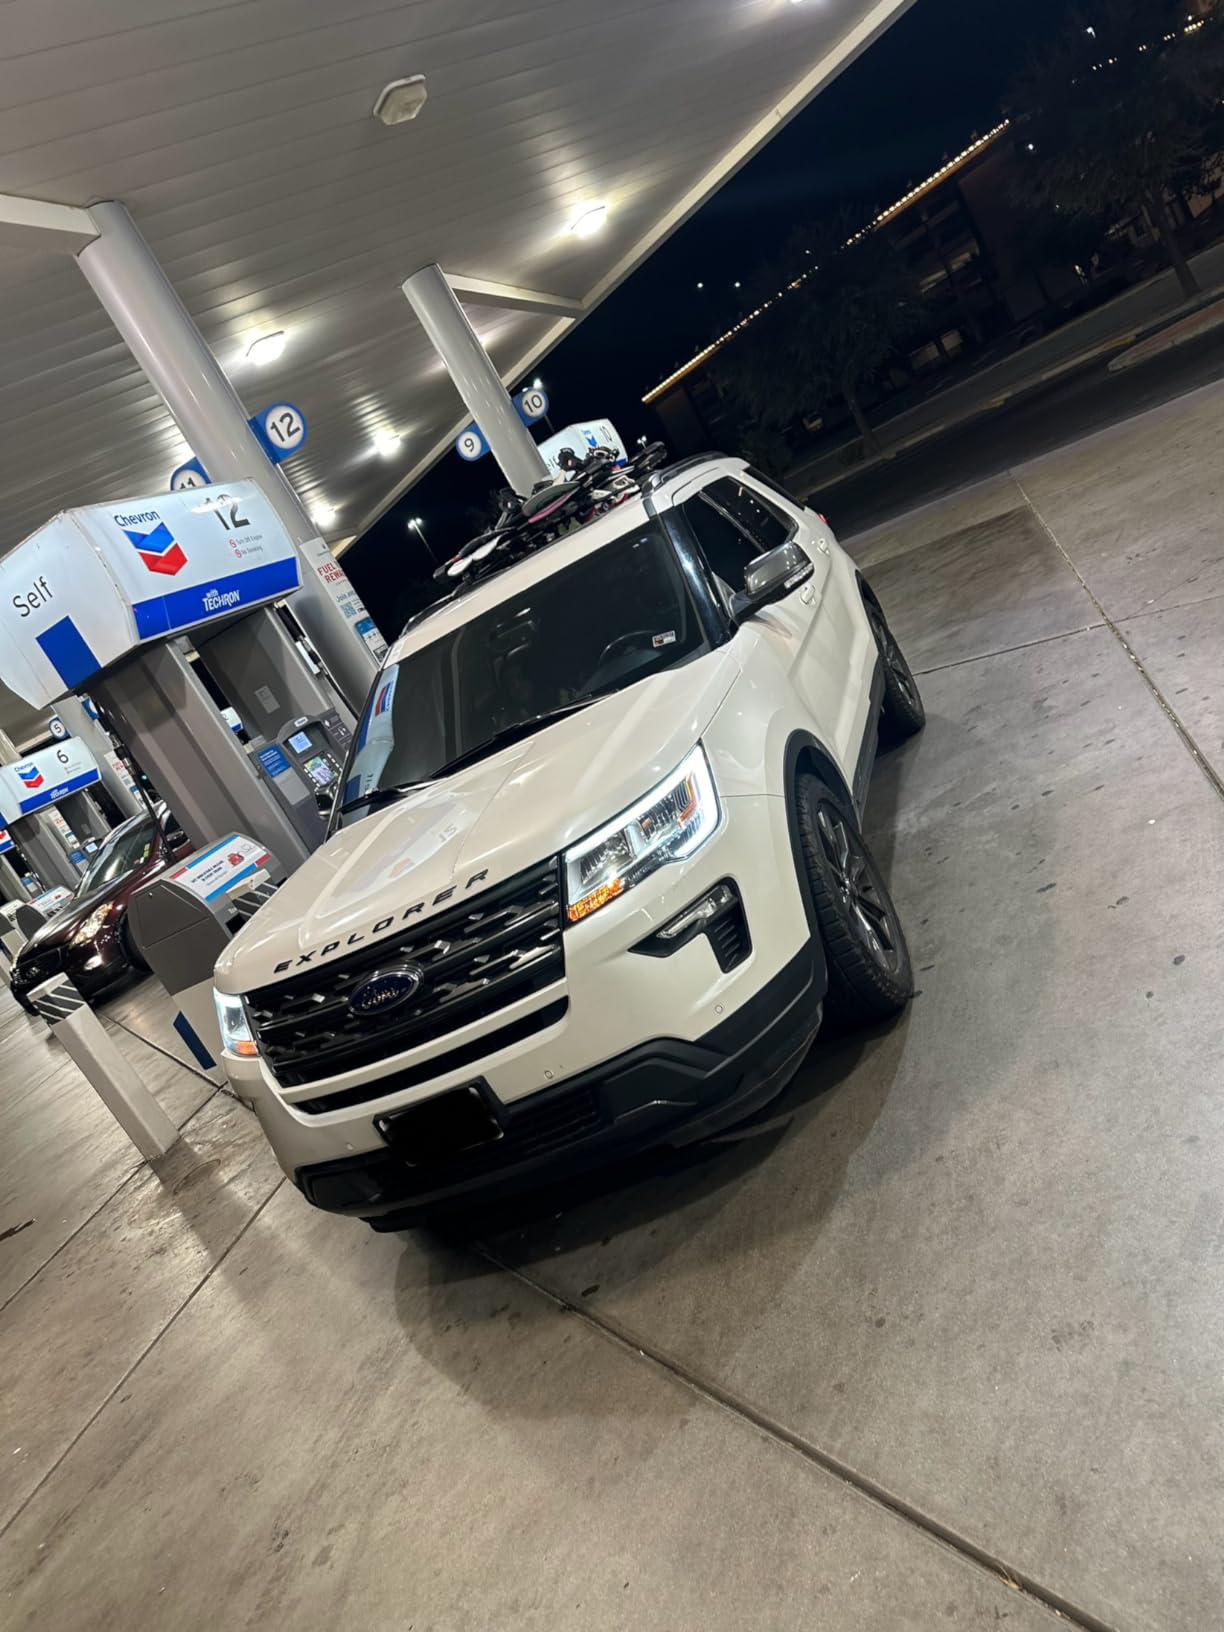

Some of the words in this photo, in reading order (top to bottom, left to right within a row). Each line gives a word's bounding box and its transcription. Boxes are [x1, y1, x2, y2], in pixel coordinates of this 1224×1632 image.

[524, 395, 543, 413] 10
[270, 412, 300, 442] 12
[464, 437, 475, 452] 9
[114, 509, 160, 527] Chevron
[204, 494, 250, 530] 12
[317, 563, 335, 576] FUEL
[12, 576, 54, 618] Self
[202, 590, 240, 611] TECHRON
[53, 723, 62, 734] 5
[56, 750, 69, 764] 6
[273, 868, 489, 974] EXPLORER
